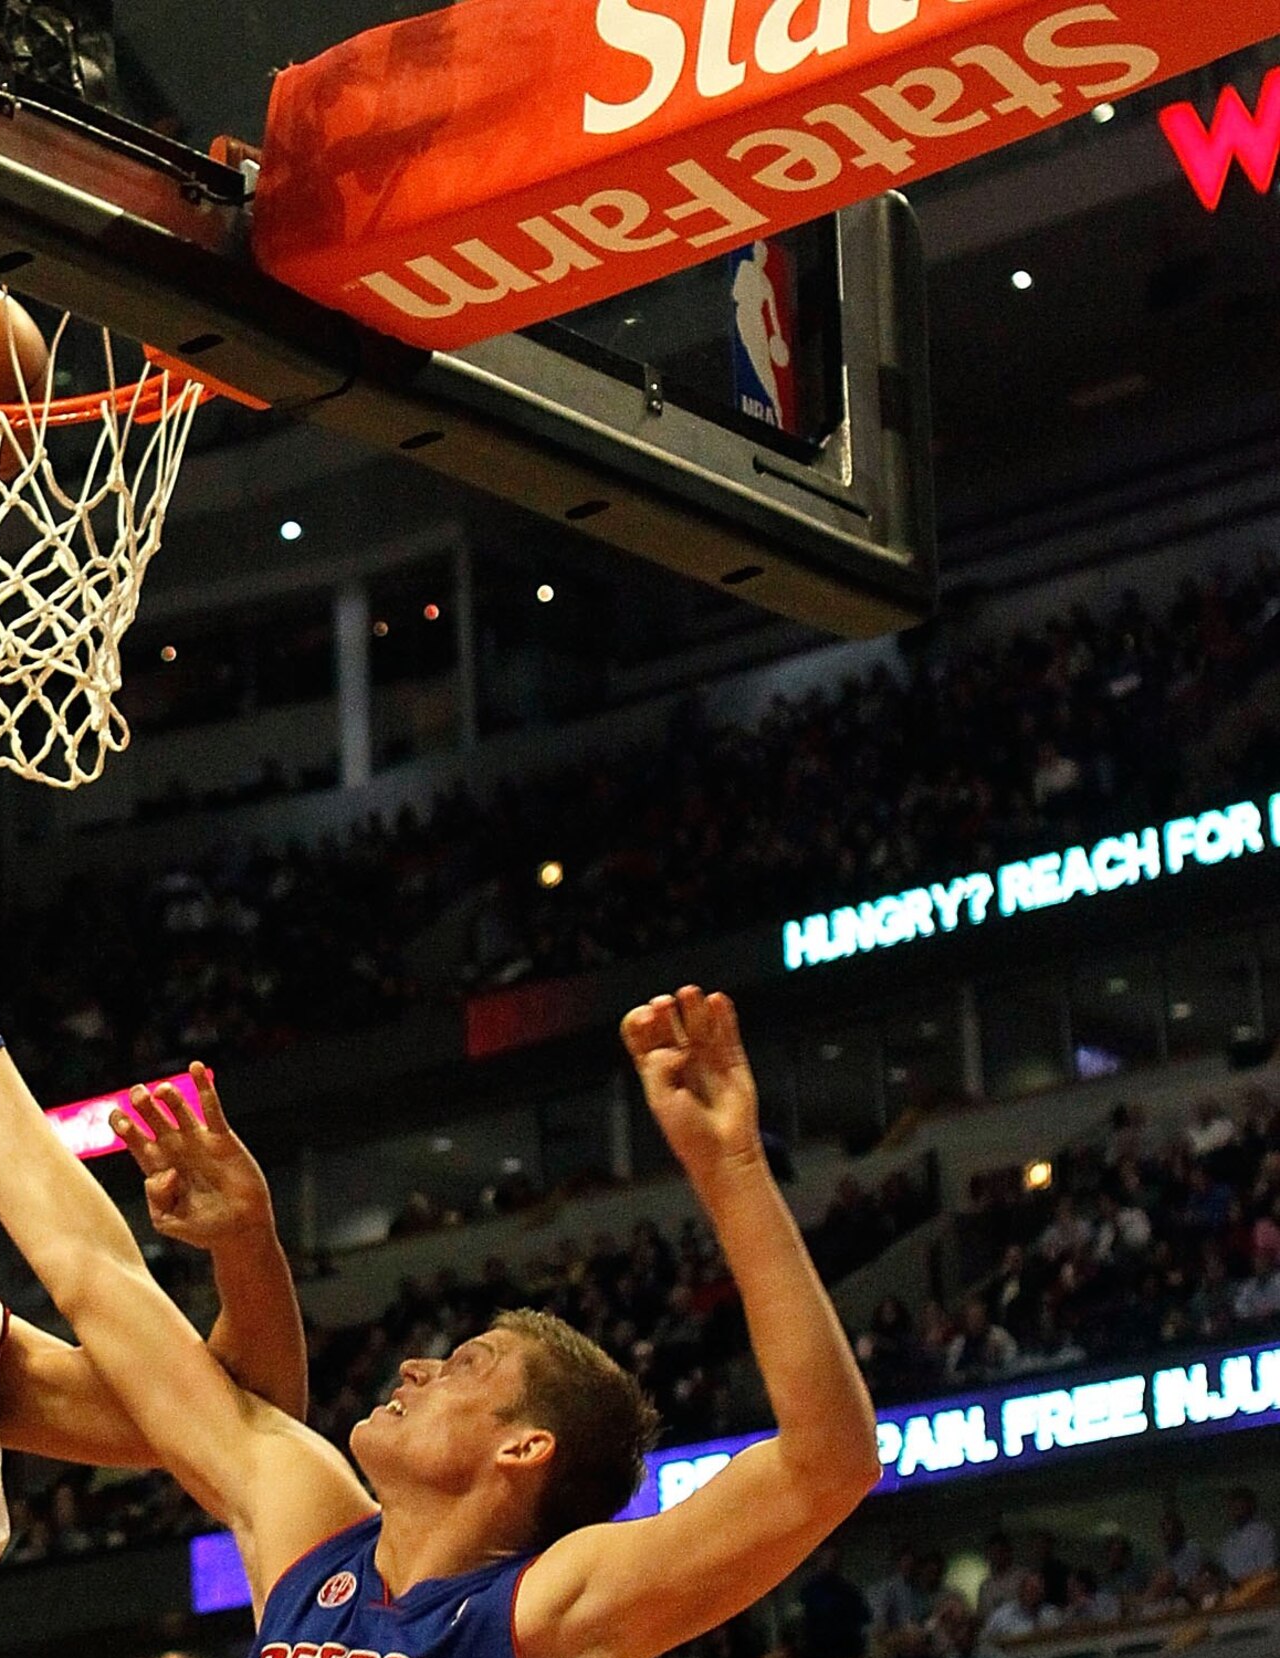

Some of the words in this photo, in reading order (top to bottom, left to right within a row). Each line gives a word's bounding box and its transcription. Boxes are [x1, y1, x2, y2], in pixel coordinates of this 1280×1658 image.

[726, 3, 1159, 192] State
[359, 159, 770, 318] Farm
[783, 872, 994, 971] HUNGRY?
[998, 828, 1160, 916] REACH
[1165, 801, 1265, 875] FOR
[1002, 1376, 1147, 1457] FREE
[1152, 1348, 1280, 1430] INJU
